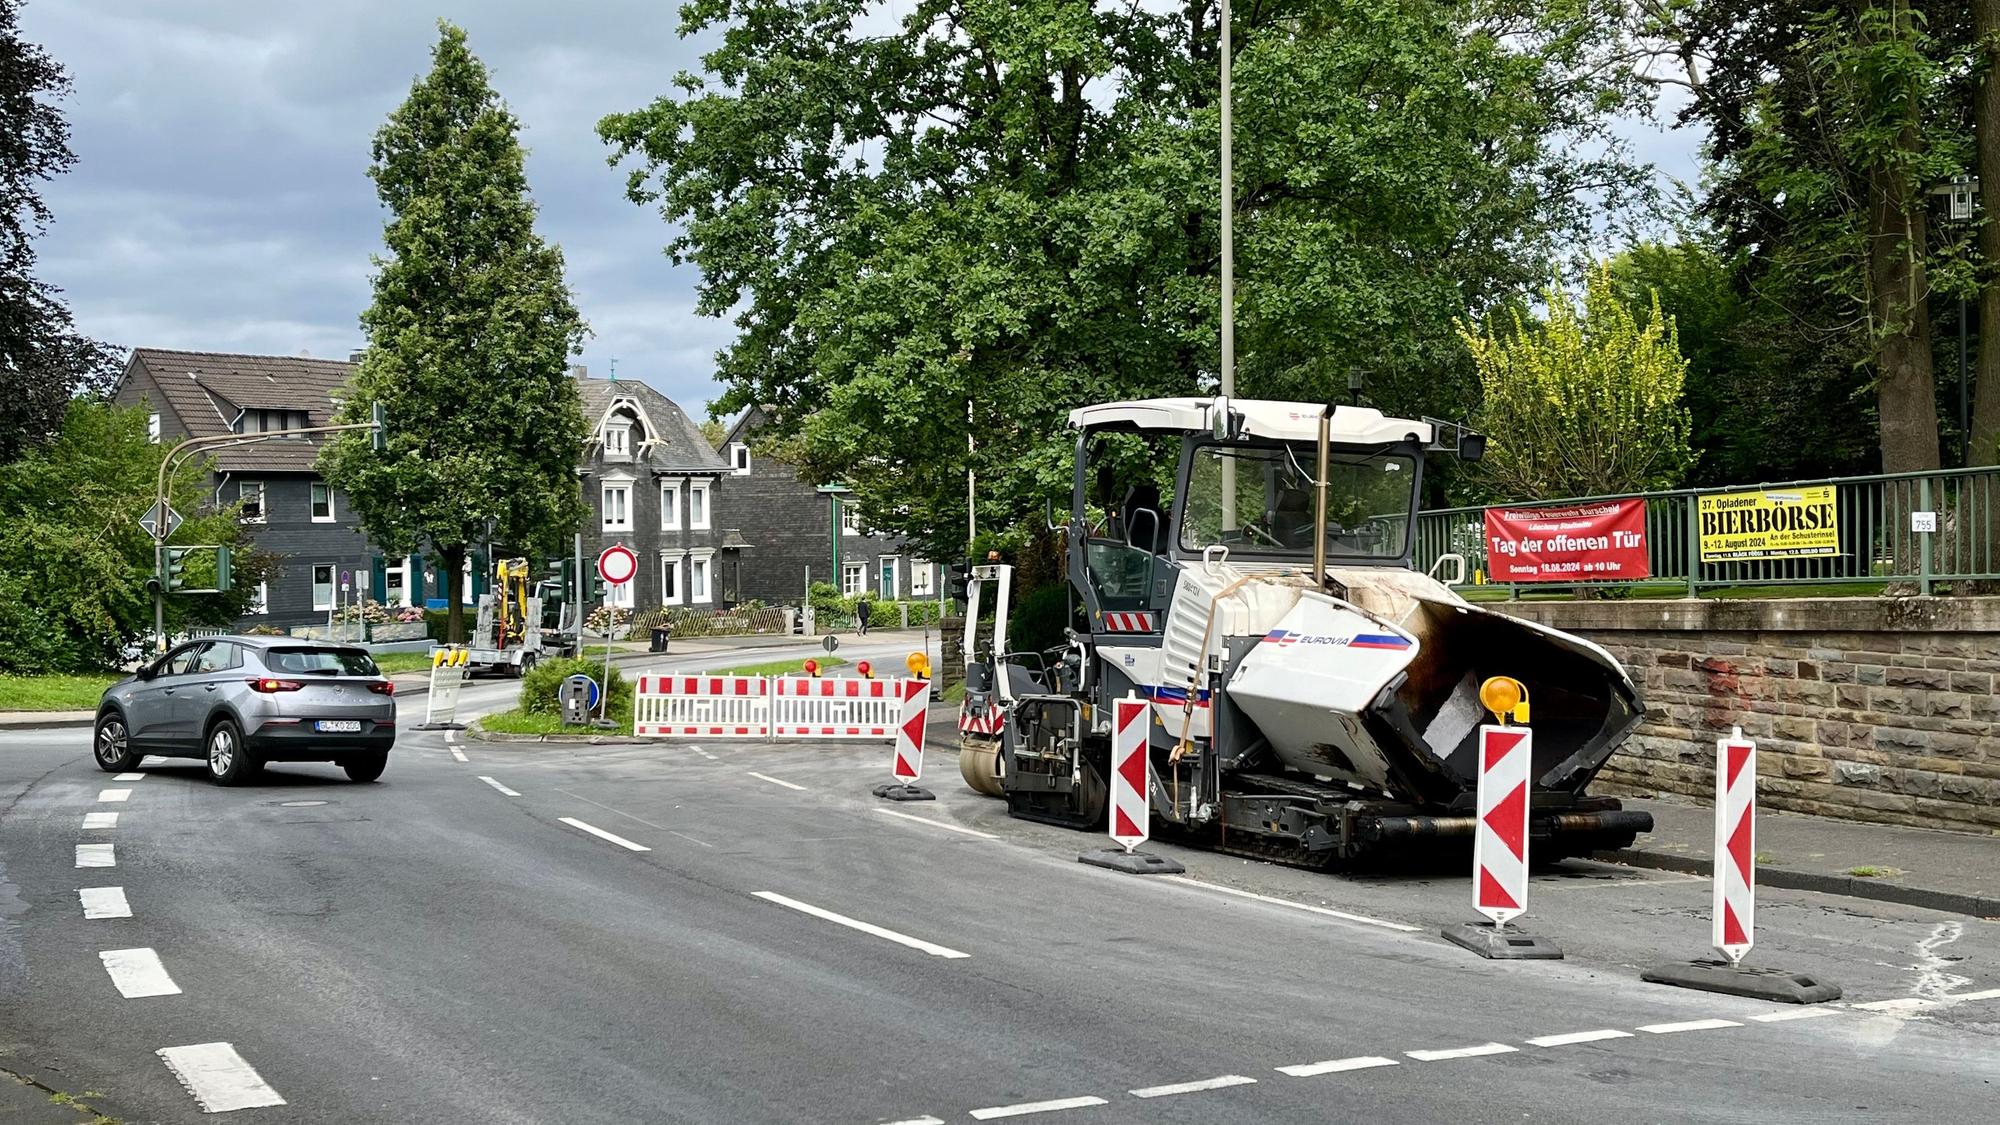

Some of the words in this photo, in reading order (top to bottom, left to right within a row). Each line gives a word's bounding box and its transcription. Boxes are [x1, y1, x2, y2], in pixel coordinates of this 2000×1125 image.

[1702, 500, 1714, 510] 37.
[1716, 498, 1757, 510] Opladener
[1541, 509, 1579, 518] Feuerwehr
[1580, 504, 1620, 516] Burscheid
[1702, 501, 1834, 536] BIERBÖRSE
[1916, 520, 1931, 530] 755
[1770, 533, 1779, 541] An
[1780, 532, 1790, 540] der
[1792, 530, 1835, 540] Schusterinsel
[1492, 536, 1517, 557] Tag
[1521, 536, 1543, 553] der
[1546, 534, 1608, 552] offenen
[1612, 530, 1642, 548] Tür
[1725, 539, 1748, 550] August
[1749, 537, 1766, 548] 2024
[1510, 564, 1538, 574] Sonntag
[1541, 561, 1580, 573] 18.08.2024
[1583, 562, 1594, 572] ab
[1595, 562, 1605, 571] 10
[1606, 561, 1621, 571] Uhr
[1300, 636, 1350, 646] EUROVIA
